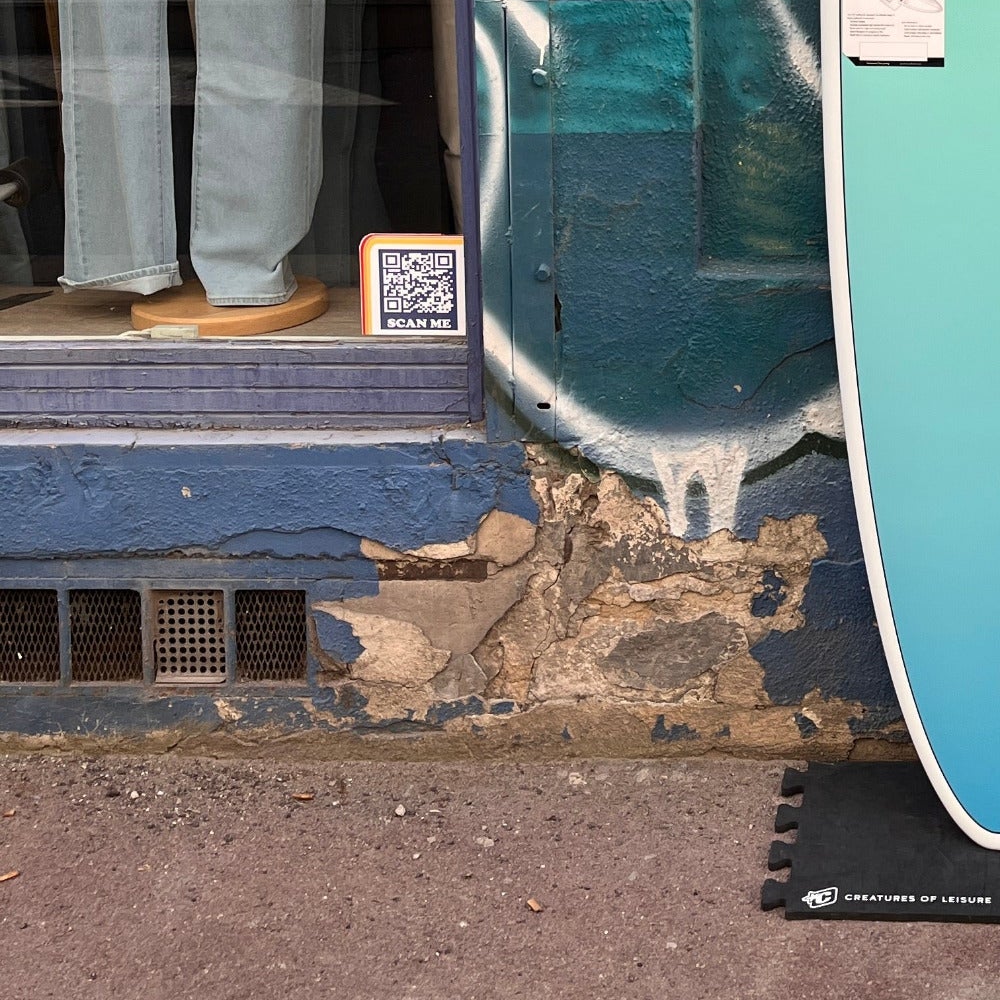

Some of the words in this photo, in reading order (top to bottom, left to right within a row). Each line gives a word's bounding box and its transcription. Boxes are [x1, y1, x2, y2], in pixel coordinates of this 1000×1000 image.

[387, 319, 427, 329] SCAN
[430, 319, 452, 329] ME
[844, 894, 916, 903] CREATURES
[920, 895, 937, 903] OF
[941, 896, 993, 905] LEISURE
